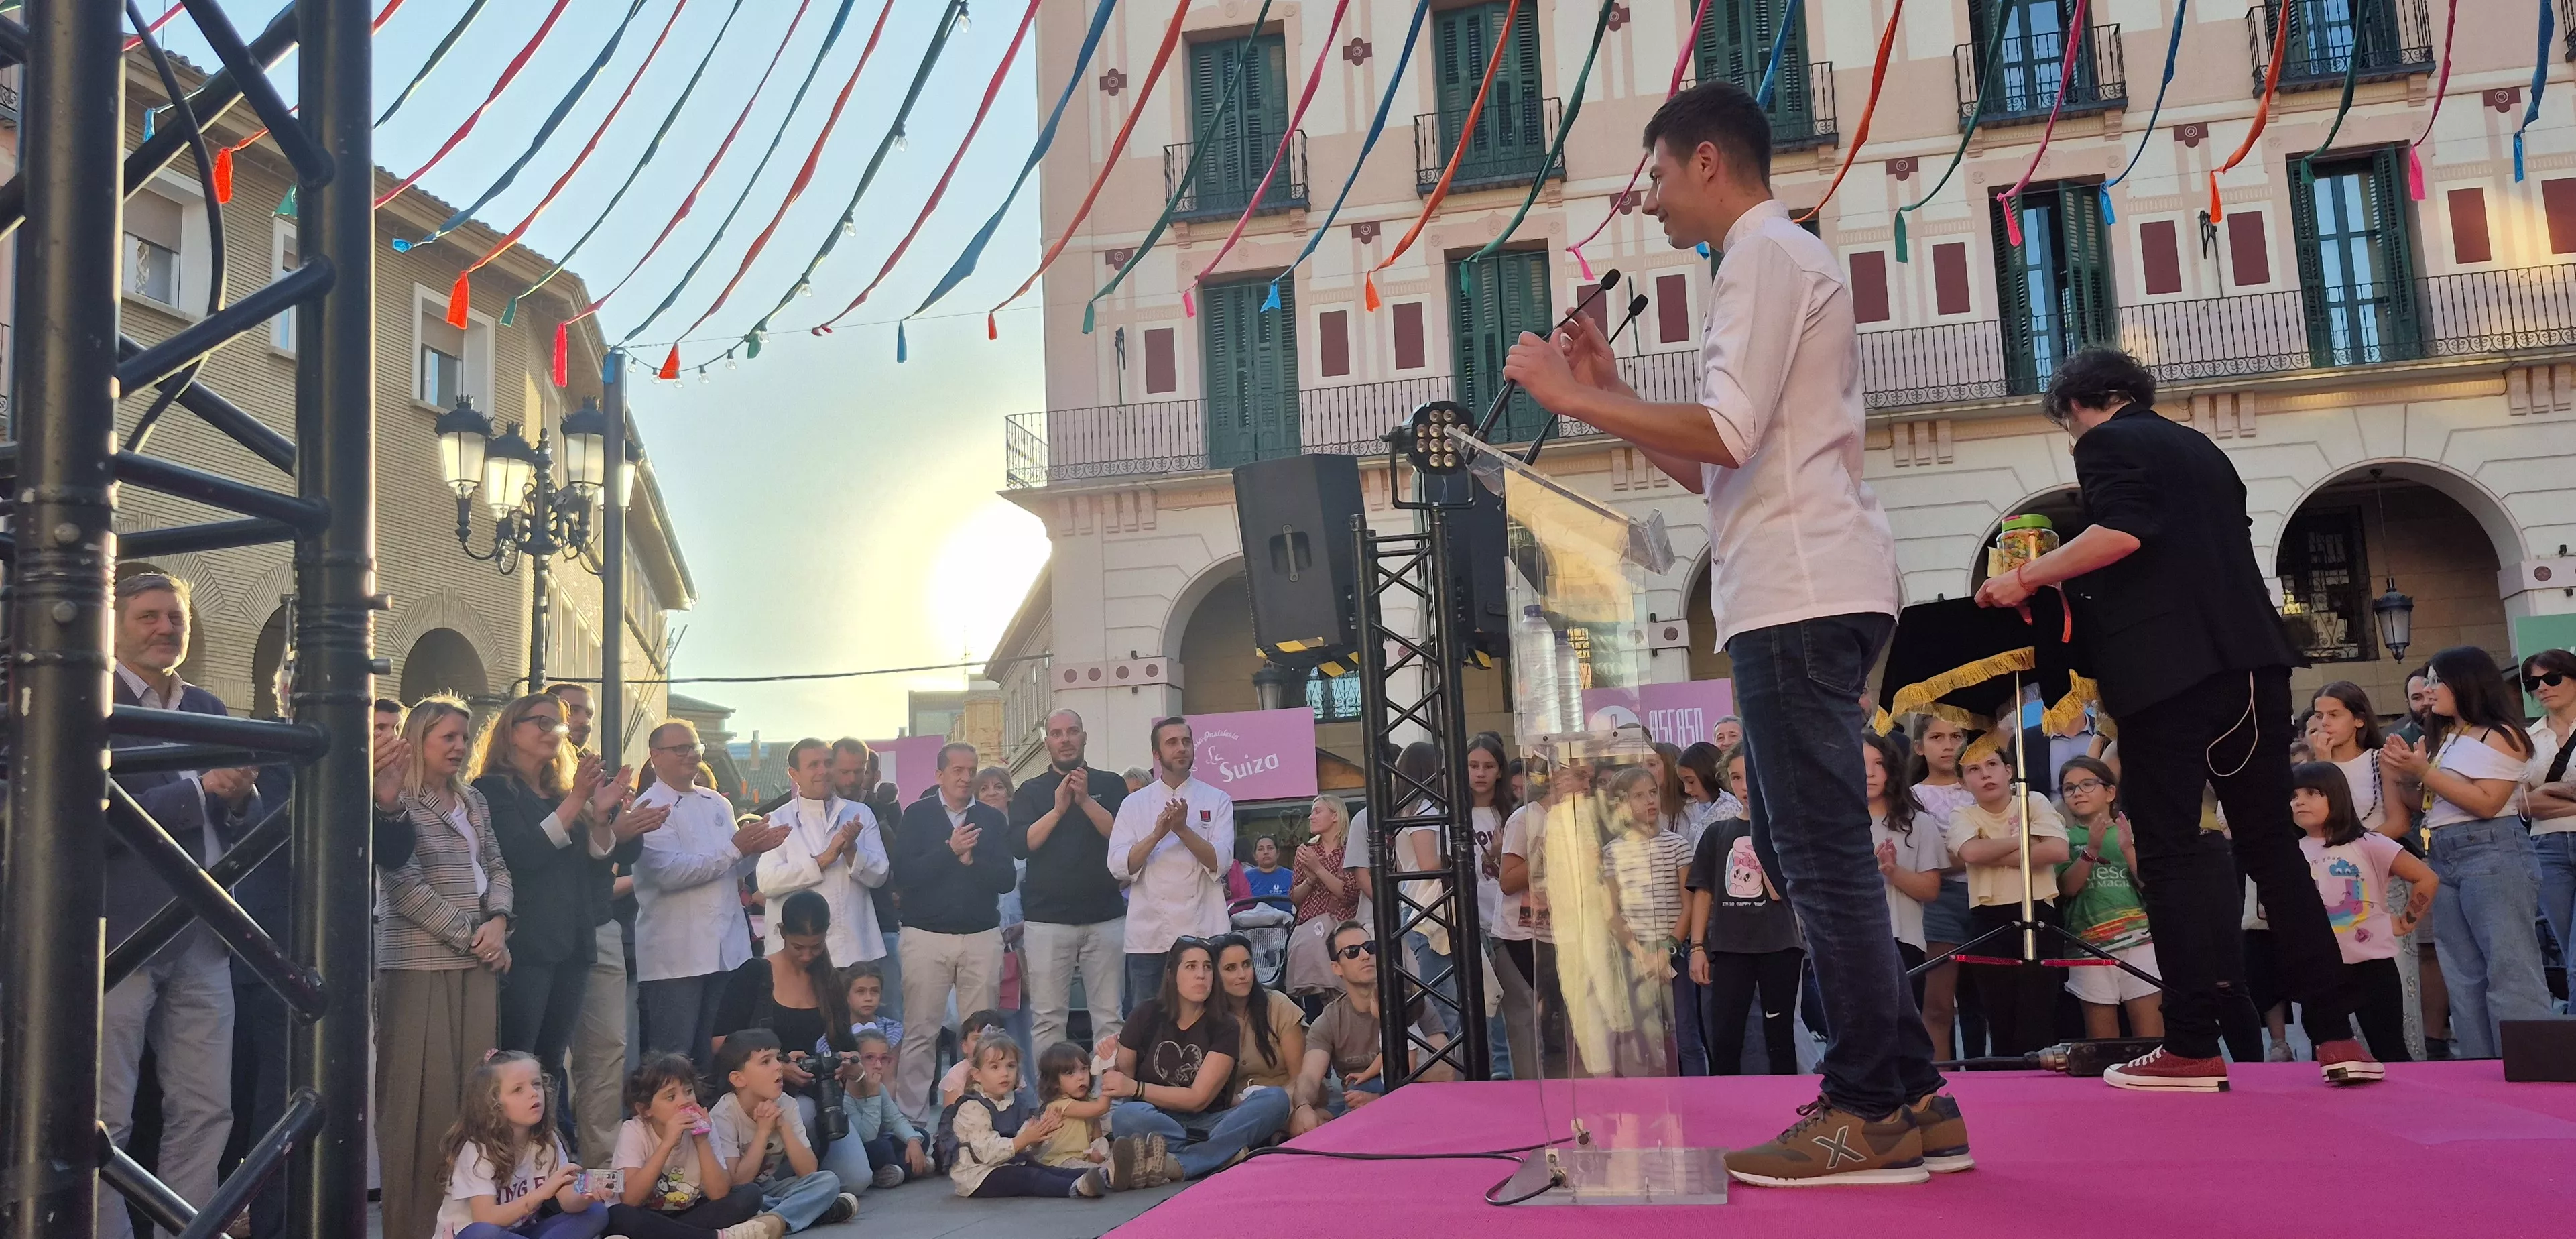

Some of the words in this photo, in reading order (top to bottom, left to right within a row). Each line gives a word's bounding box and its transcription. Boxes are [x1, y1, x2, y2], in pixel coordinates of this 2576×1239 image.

[1649, 707, 1705, 748] ASCASO
[1205, 746, 1224, 765] La
[1219, 753, 1279, 783] Suiza
